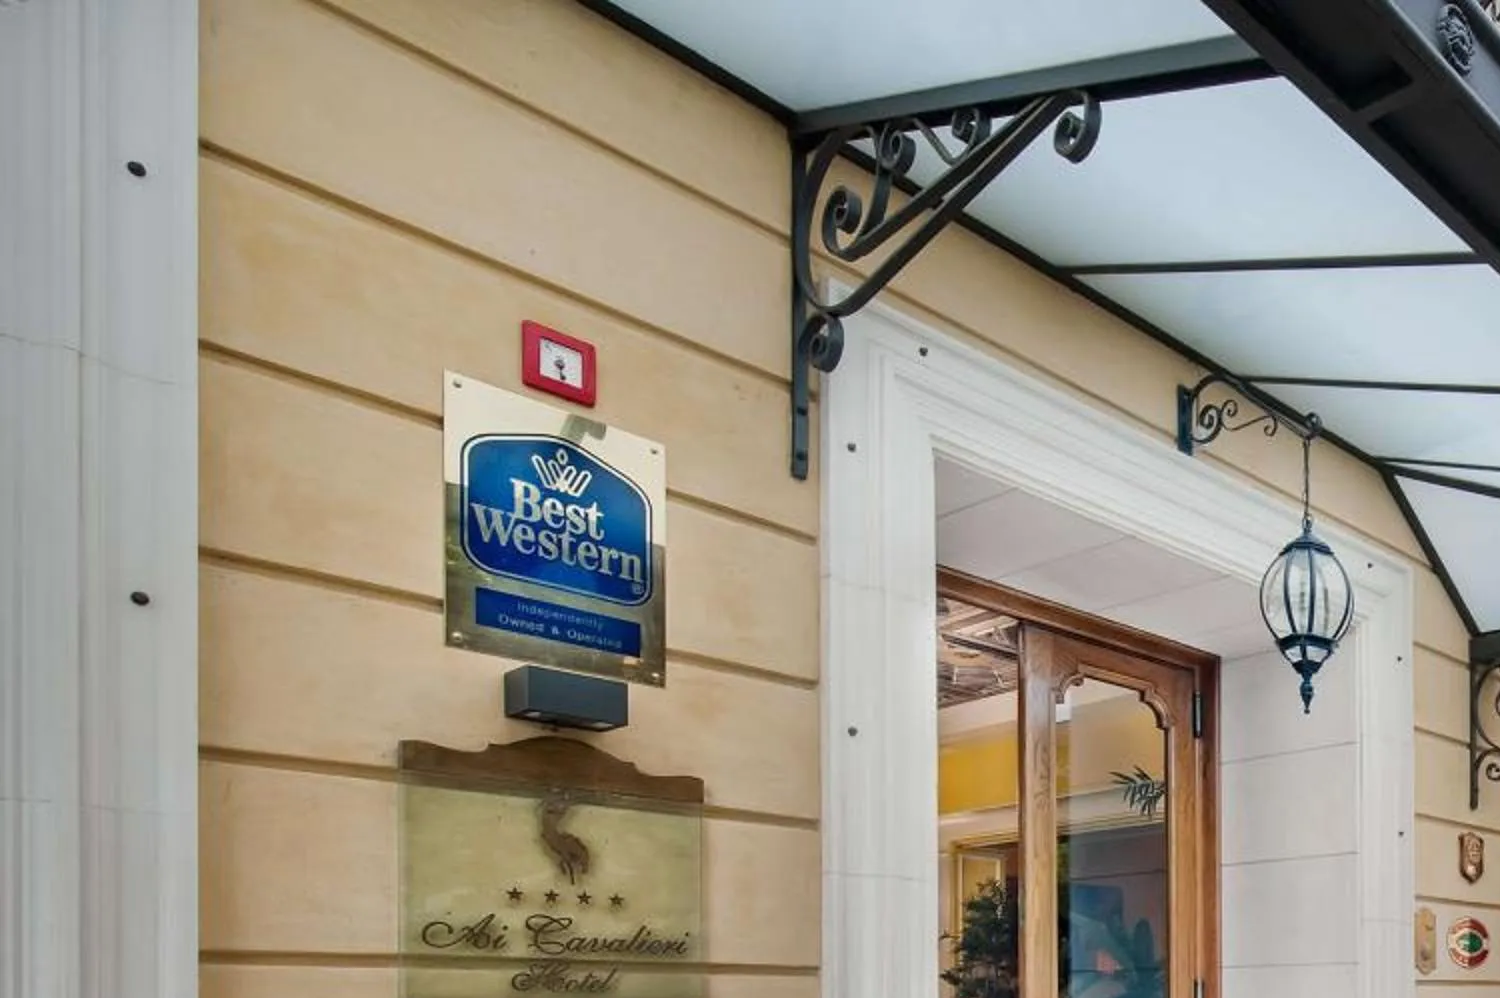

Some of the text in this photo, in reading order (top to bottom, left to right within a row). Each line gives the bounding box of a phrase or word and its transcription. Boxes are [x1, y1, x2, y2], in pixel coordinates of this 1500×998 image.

[510, 477, 606, 541] Best
[470, 502, 644, 584] Western
[421, 913, 509, 951] Ai
[511, 960, 618, 994] Hotel
